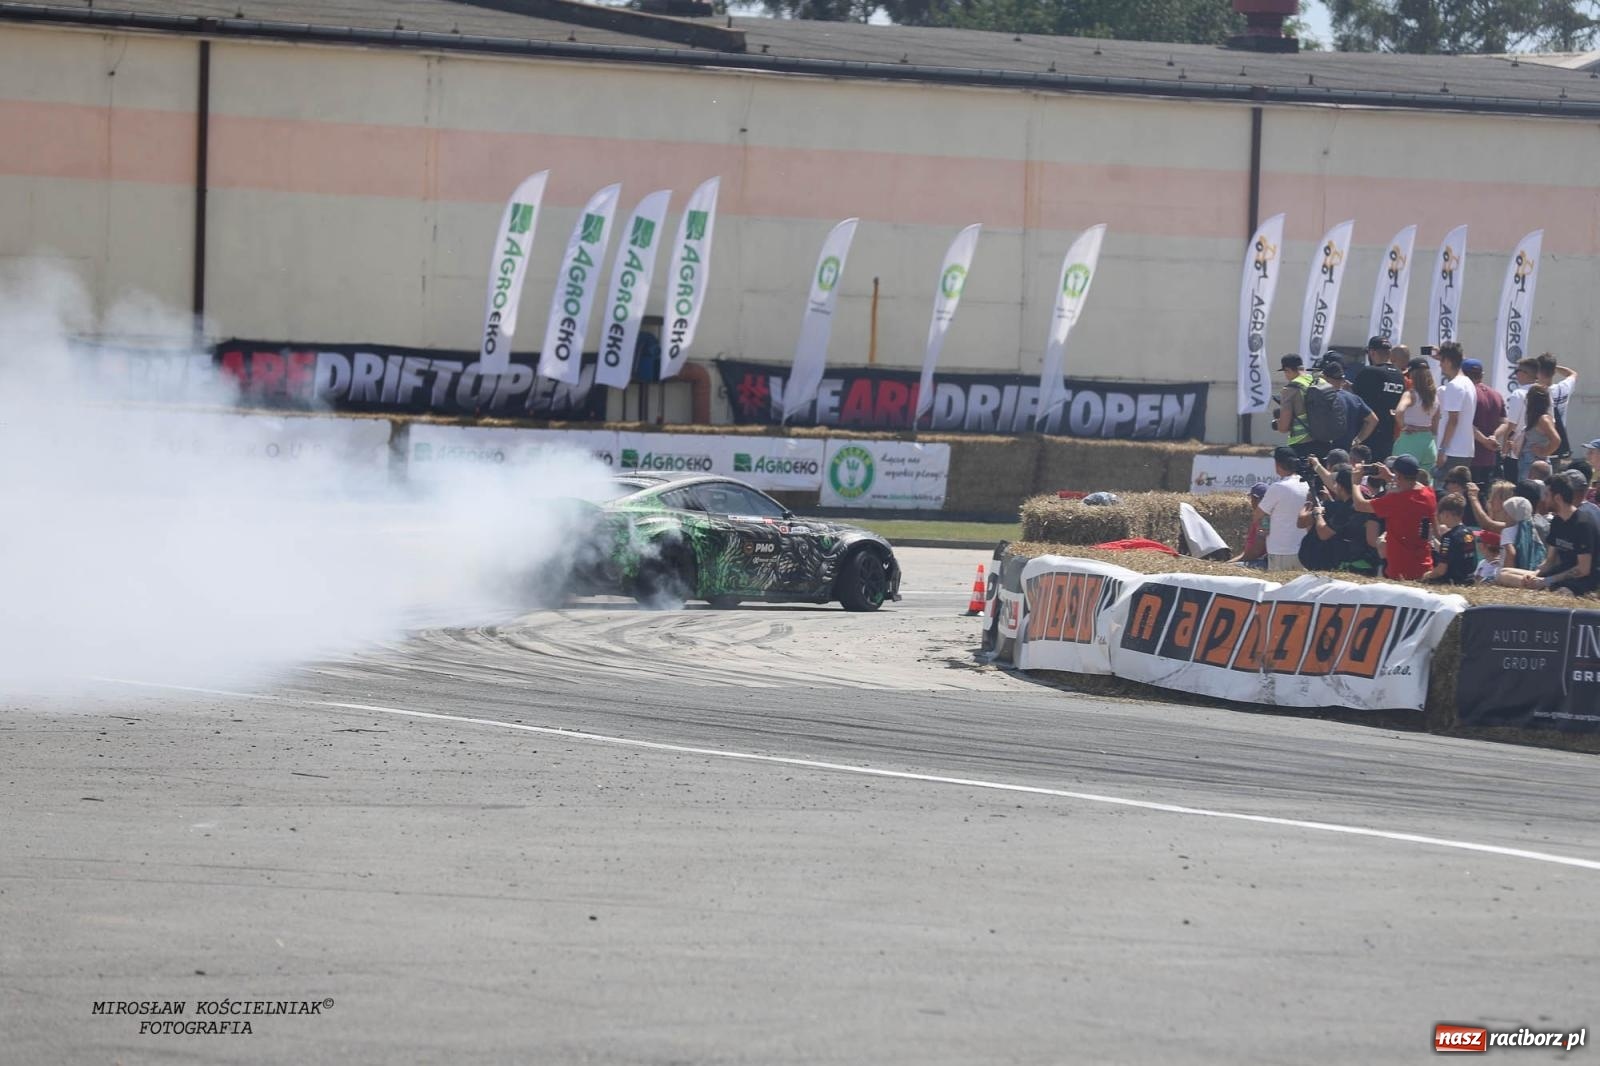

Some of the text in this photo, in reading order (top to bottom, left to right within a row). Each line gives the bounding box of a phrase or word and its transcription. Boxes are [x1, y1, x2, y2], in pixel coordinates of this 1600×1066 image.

[485, 238, 525, 355] AGROEKO
[555, 245, 594, 362] AGROEKO
[604, 250, 644, 368] AGROEKO
[668, 244, 701, 360] AGROEKO
[1247, 294, 1266, 408] AGRONOVA
[640, 451, 713, 471] AGROEKO
[754, 456, 819, 476] AGROEKO
[755, 543, 775, 553] PMO
[1492, 629, 1560, 644] AUTO FUS
[1503, 657, 1547, 671] GROUP
